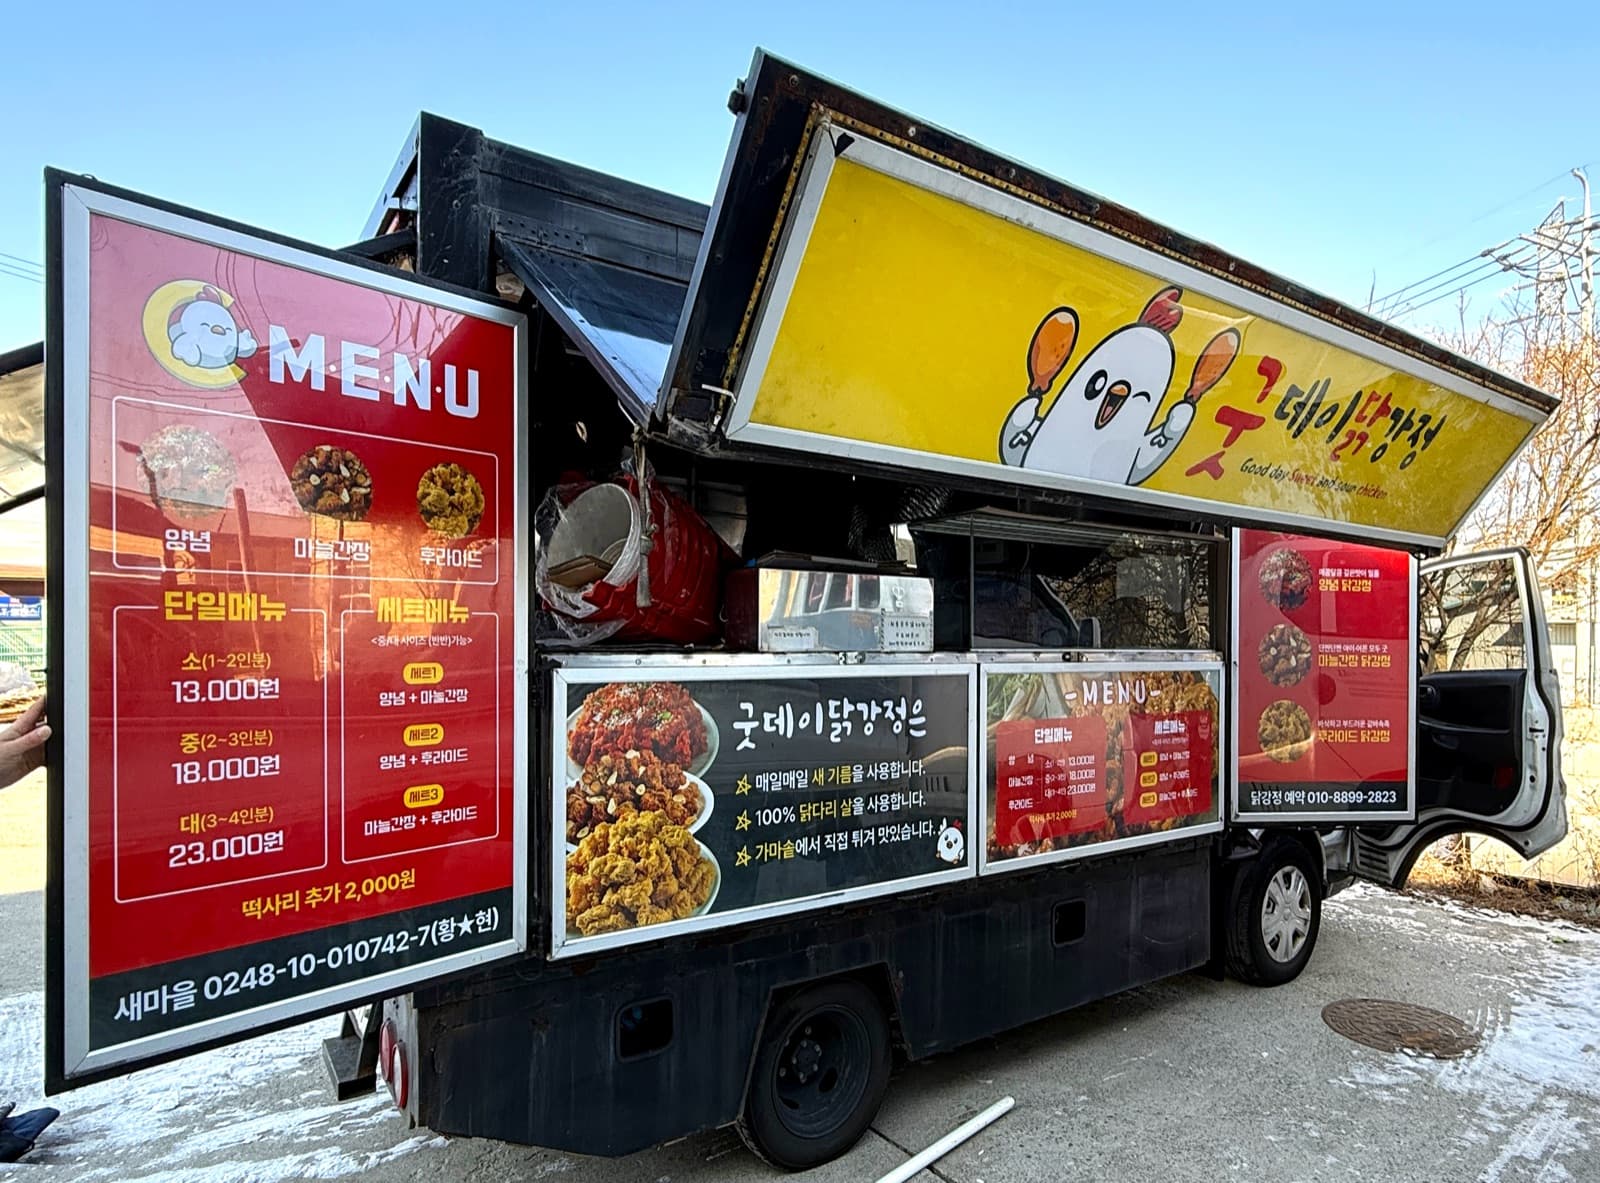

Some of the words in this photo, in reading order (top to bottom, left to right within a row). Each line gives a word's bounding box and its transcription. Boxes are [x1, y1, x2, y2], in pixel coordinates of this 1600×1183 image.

[1240, 457, 1272, 477] Good
[1270, 466, 1289, 482] day
[1317, 474, 1338, 488] and
[165, 529, 210, 552] 양념
[294, 538, 370, 561] 마늘간장
[420, 546, 482, 568] 후라이드
[1319, 579, 1339, 592] 양념
[1342, 579, 1371, 592] 닭강정
[165, 591, 286, 621] 단일메뉴
[377, 597, 469, 623] 세트메뉴
[401, 635, 427, 646] 사이즈
[181, 652, 271, 671] 소(1~2인분)
[410, 667, 437, 679] 세트1
[1318, 655, 1359, 668] 마늘간장
[1361, 655, 1391, 668] 닭강정
[379, 691, 405, 706] 양념
[420, 688, 468, 704] 마늘간장
[409, 727, 439, 742] 세트2
[733, 697, 926, 750] 굿데이닭강정은
[180, 729, 273, 754] 중(2~3인분)
[1034, 727, 1073, 744] 단일메뉴
[1318, 730, 1358, 743] 후라이드
[1361, 730, 1390, 743] 닭강정
[380, 754, 406, 769] 양념
[421, 748, 468, 765] 후라이드
[756, 769, 808, 792] 매일매일
[812, 768, 824, 786] 새
[828, 764, 864, 785] 기름을
[867, 760, 926, 780] 사용합니다.
[409, 788, 439, 803] 세트3
[1251, 790, 1282, 806] 닭강정
[1284, 791, 1306, 806] 예약
[1308, 791, 1397, 804] 010-8899-2823
[180, 806, 274, 834] 대(3~4인분)
[755, 807, 796, 826] 100%
[800, 800, 836, 821] 닭다리
[840, 797, 864, 816] 살을
[867, 791, 926, 813] 사용합니다.
[364, 814, 416, 836] 마늘간장
[431, 805, 478, 825] 후라이드
[755, 836, 820, 862] 가마솥에서
[824, 832, 848, 851] 직접
[852, 828, 874, 848] 튀겨
[878, 820, 936, 844] 맛있습니다.
[242, 889, 300, 921] 떡사리
[305, 883, 340, 908] 추가
[345, 868, 417, 902] 2,000원
[113, 979, 197, 1023] 새마을
